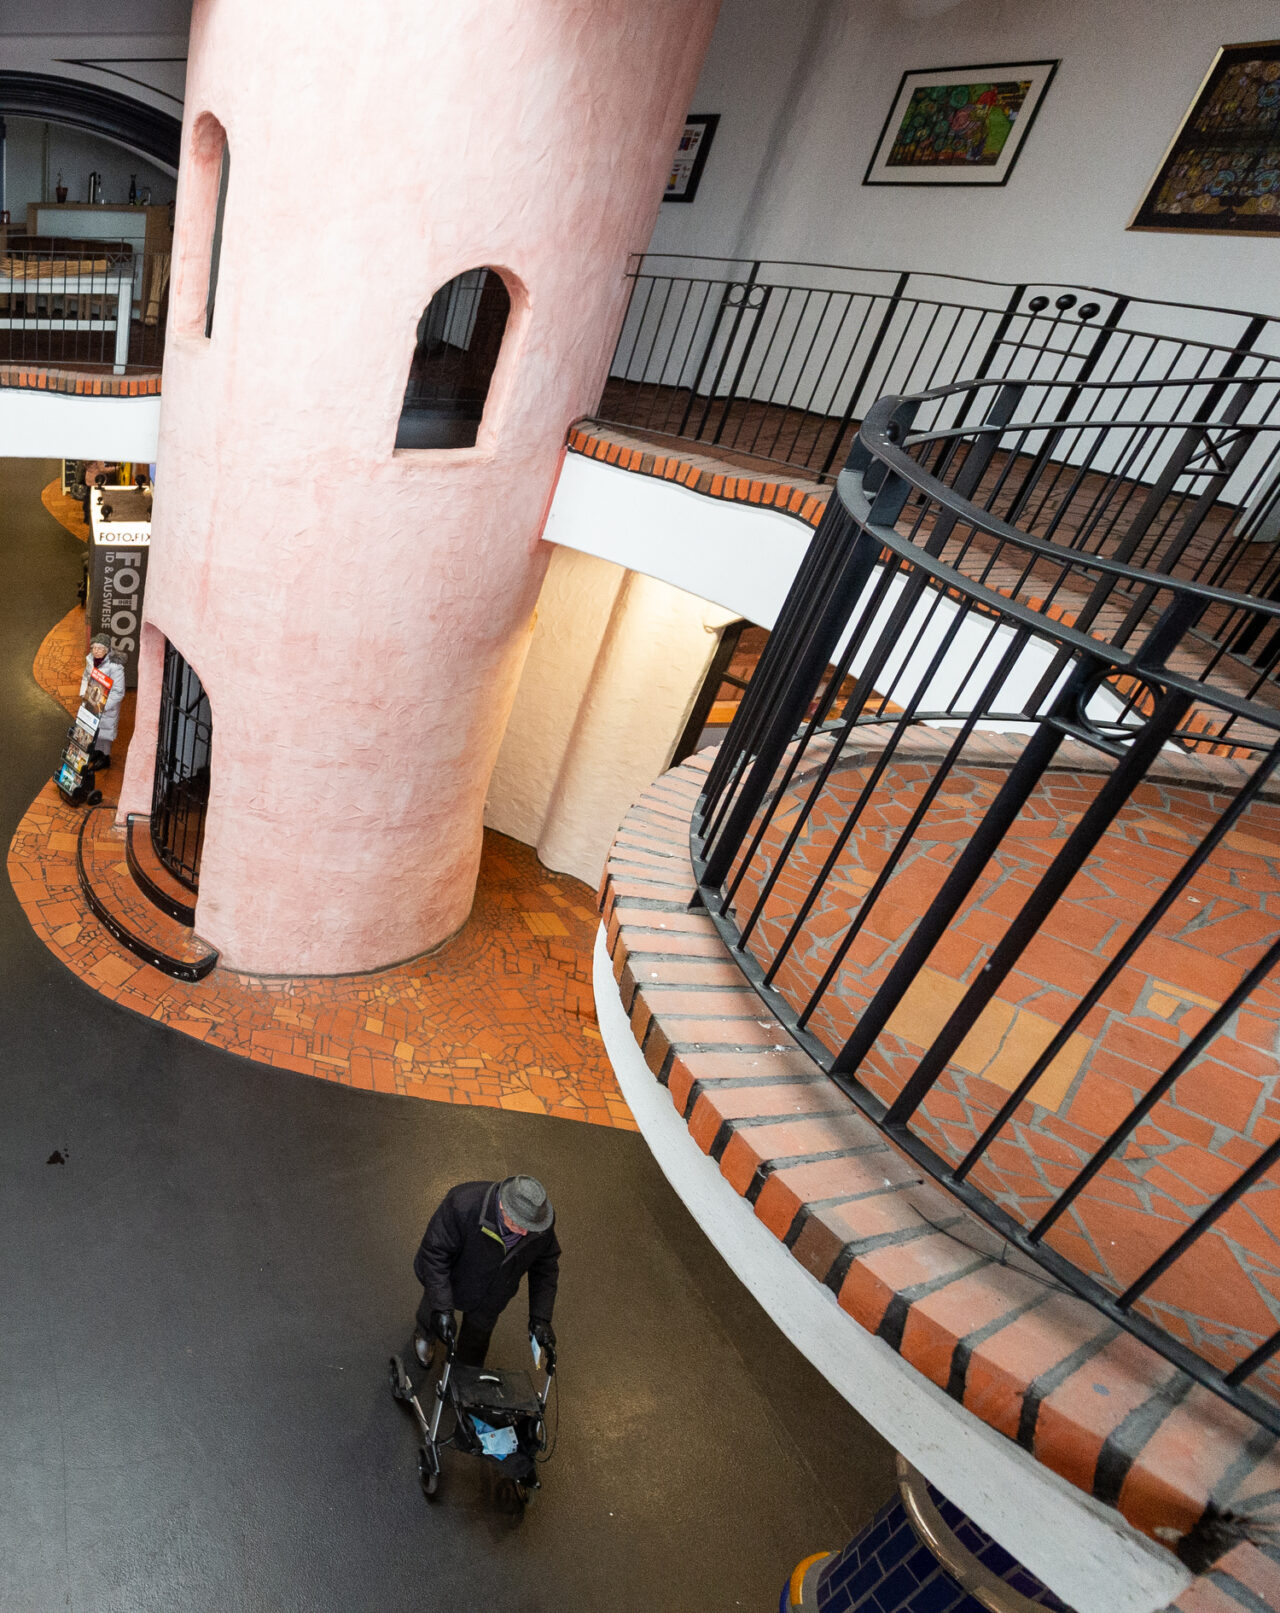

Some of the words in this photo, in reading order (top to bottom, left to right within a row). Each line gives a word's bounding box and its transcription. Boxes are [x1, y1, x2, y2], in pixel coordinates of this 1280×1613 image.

[104, 566, 114, 574] &
[105, 551, 115, 563] ID
[101, 577, 113, 629] AUSWEISE
[111, 551, 142, 652] FOTOS
